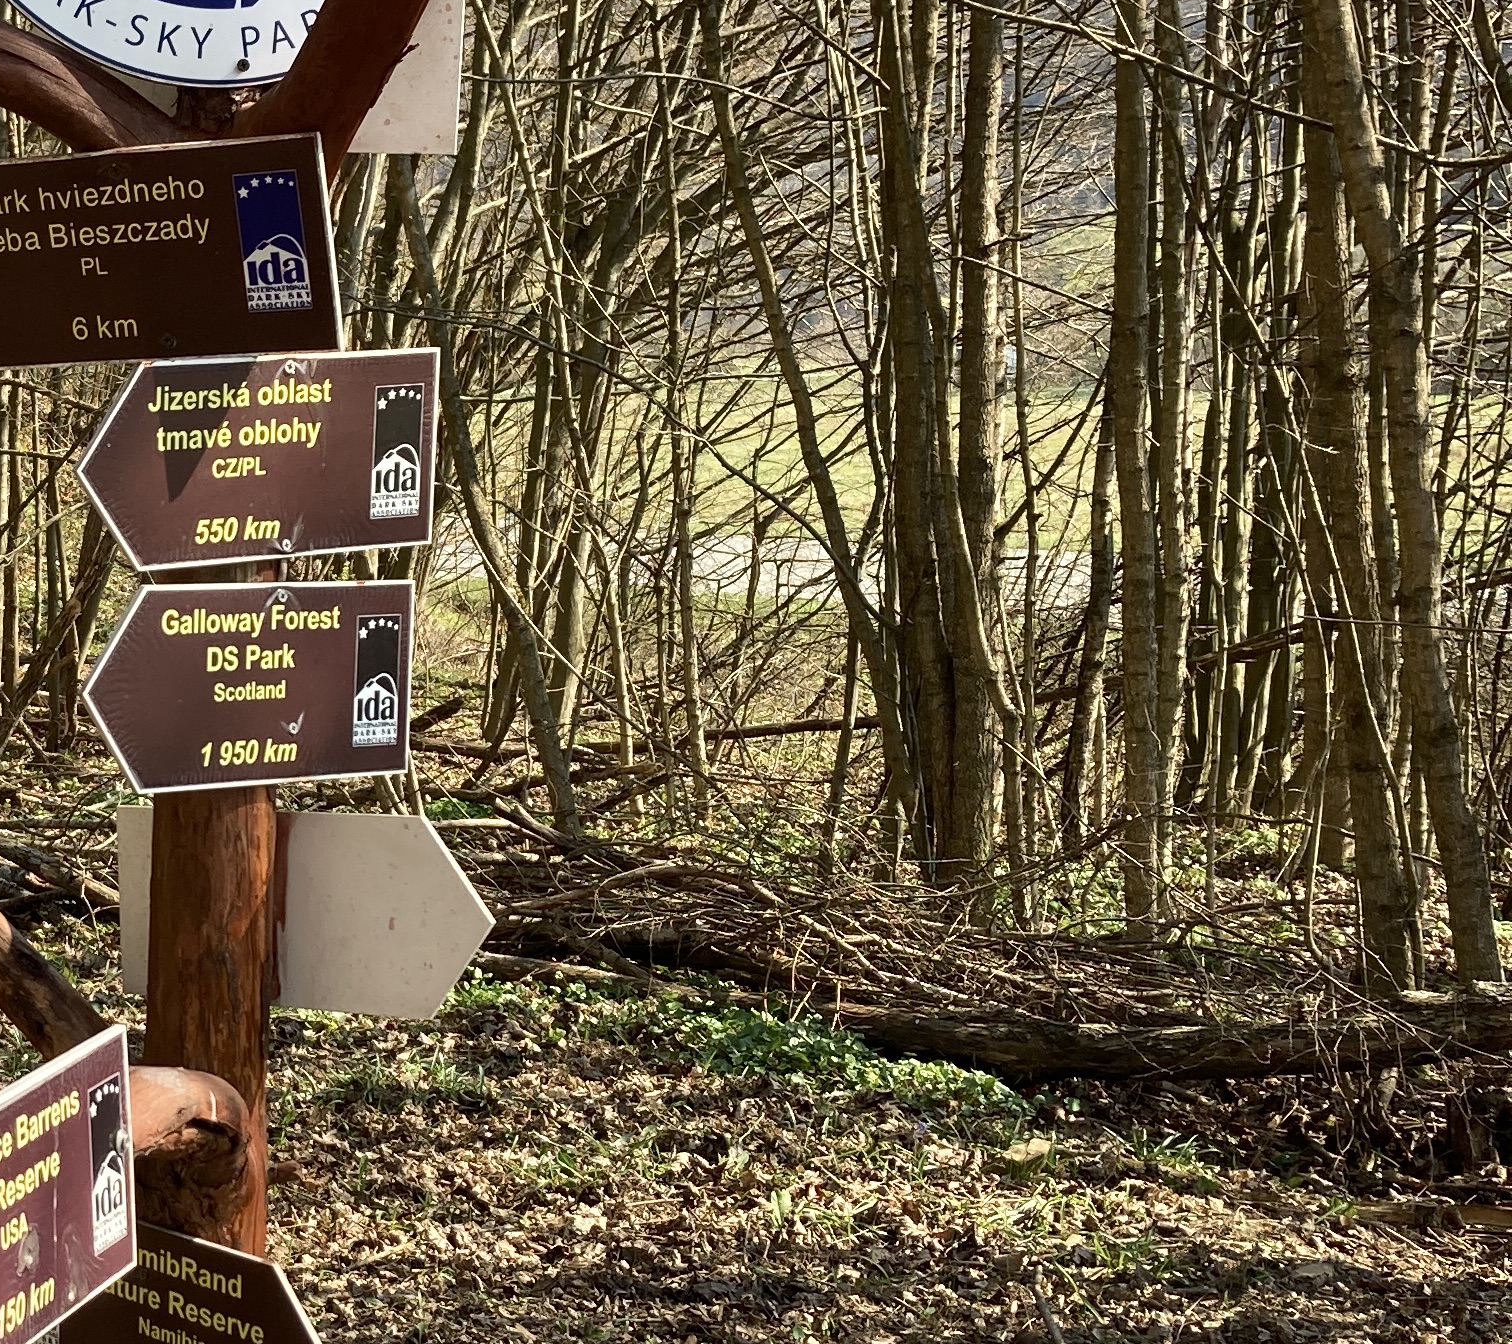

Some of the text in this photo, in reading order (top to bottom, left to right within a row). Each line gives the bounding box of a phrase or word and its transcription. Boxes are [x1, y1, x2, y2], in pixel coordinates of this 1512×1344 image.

[241, 9, 319, 58] PAR
[39, 176, 205, 211] hviezdneho
[49, 213, 210, 250] Bieszczady
[80, 257, 108, 276] PL
[72, 315, 138, 341] 6 km
[147, 378, 333, 413] Jizerská oblast
[156, 417, 322, 452] tmavé oblohy
[212, 456, 267, 479] CZ/PL
[195, 515, 281, 545] 550 km
[161, 604, 341, 638] Galloway Forest
[206, 644, 296, 673] DS Park
[213, 679, 286, 703] Scotland
[200, 738, 298, 767] 1 950 km
[15, 1089, 81, 1154] Barrens
[0, 1212, 29, 1252] USA
[139, 1245, 243, 1299] mibRand
[30, 1276, 56, 1316] km
[168, 1295, 265, 1344] Reserve
